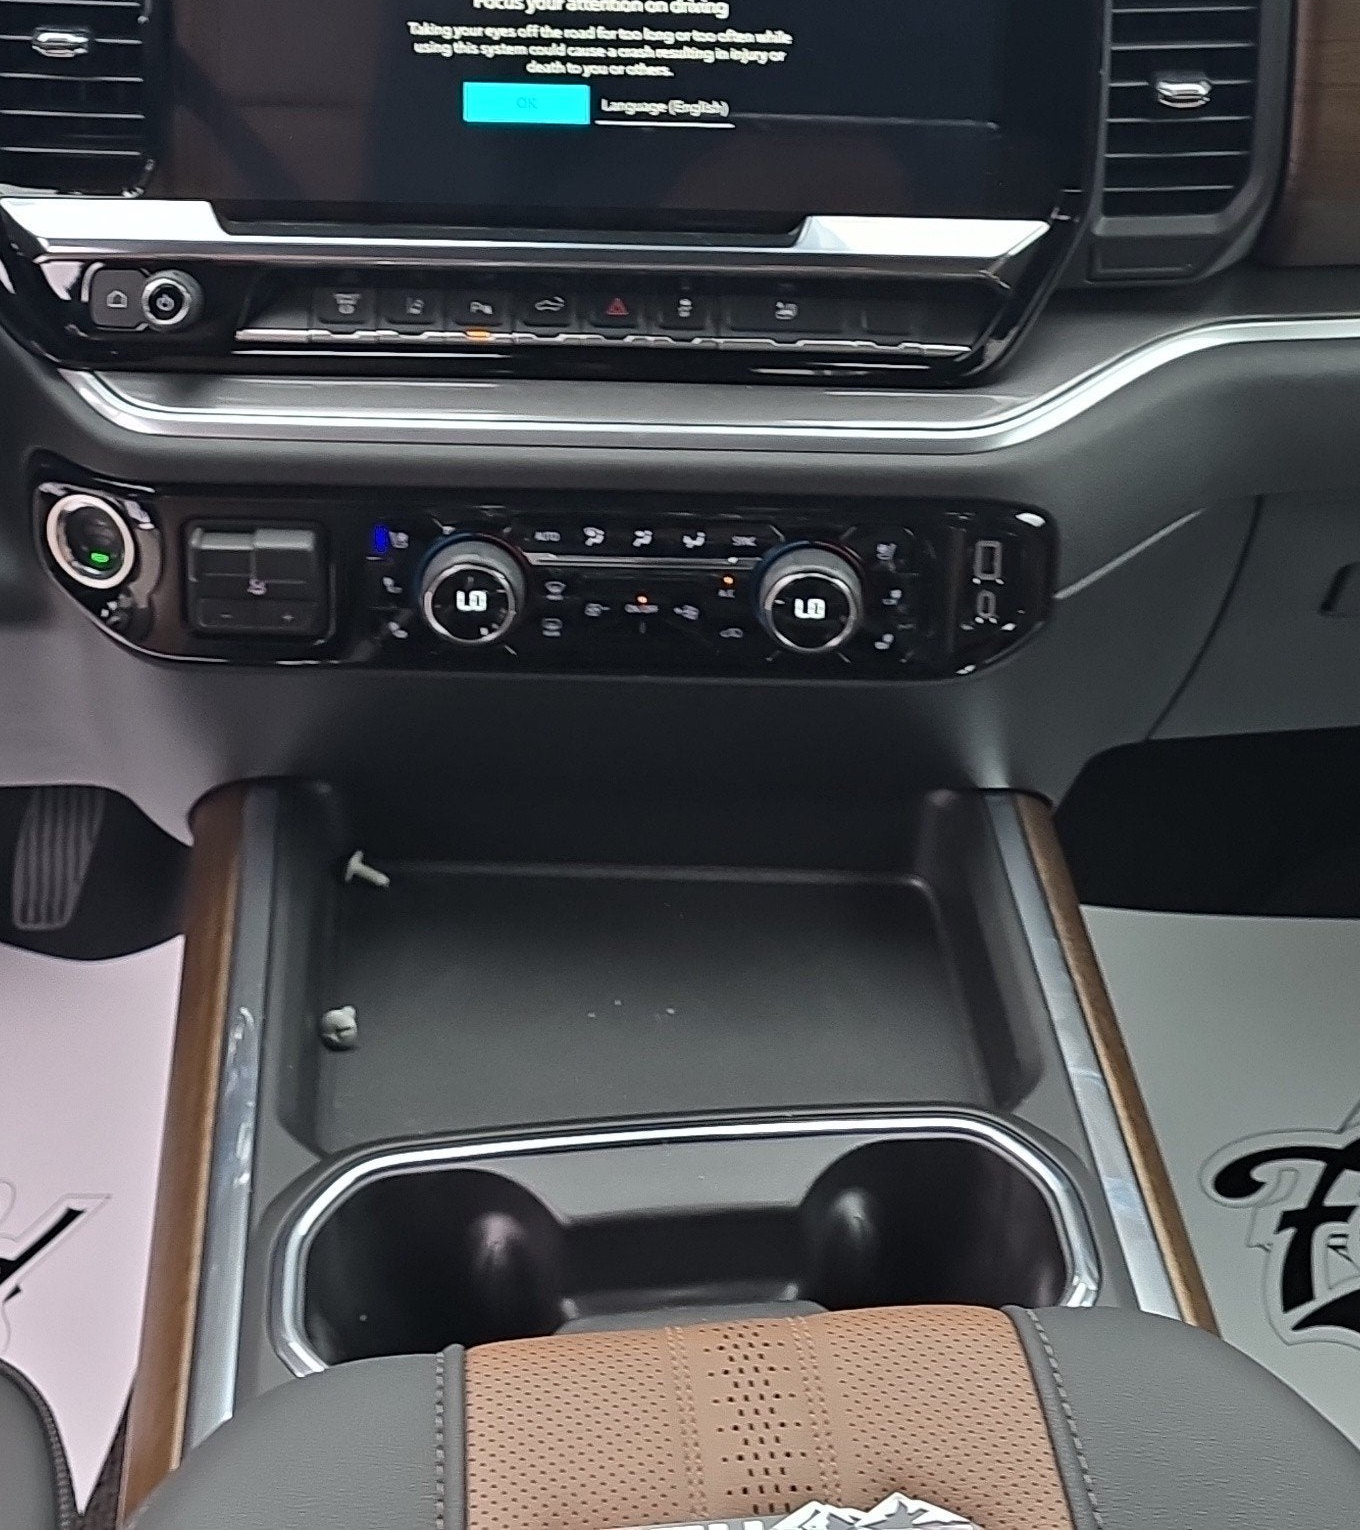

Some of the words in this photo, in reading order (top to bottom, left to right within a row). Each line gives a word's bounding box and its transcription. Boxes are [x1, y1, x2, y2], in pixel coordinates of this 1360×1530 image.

[644, 0, 669, 13] on
[407, 21, 452, 40] Taking
[452, 26, 484, 39] your
[484, 26, 517, 40] eyes
[517, 24, 539, 38] off
[539, 25, 563, 39] the
[563, 26, 596, 40] road
[596, 25, 617, 40] for
[617, 28, 643, 41] too
[643, 26, 675, 44] long
[675, 31, 691, 42] or
[691, 29, 717, 42] too
[717, 28, 755, 43] often
[755, 29, 793, 44] while
[414, 41, 453, 57] using
[453, 41, 480, 55] this
[480, 43, 528, 58] system
[528, 42, 566, 56] could
[567, 45, 607, 58] cause
[607, 47, 617, 57] a
[617, 45, 656, 58] crash
[656, 45, 715, 63] resulting
[715, 47, 729, 60] in
[729, 47, 768, 64] injury
[769, 50, 787, 62] or
[526, 59, 566, 74] death
[566, 62, 582, 74] to
[582, 64, 608, 78] you
[608, 65, 624, 75] or
[516, 96, 538, 110] OK
[600, 98, 668, 116] Language
[668, 99, 729, 117] (English)
